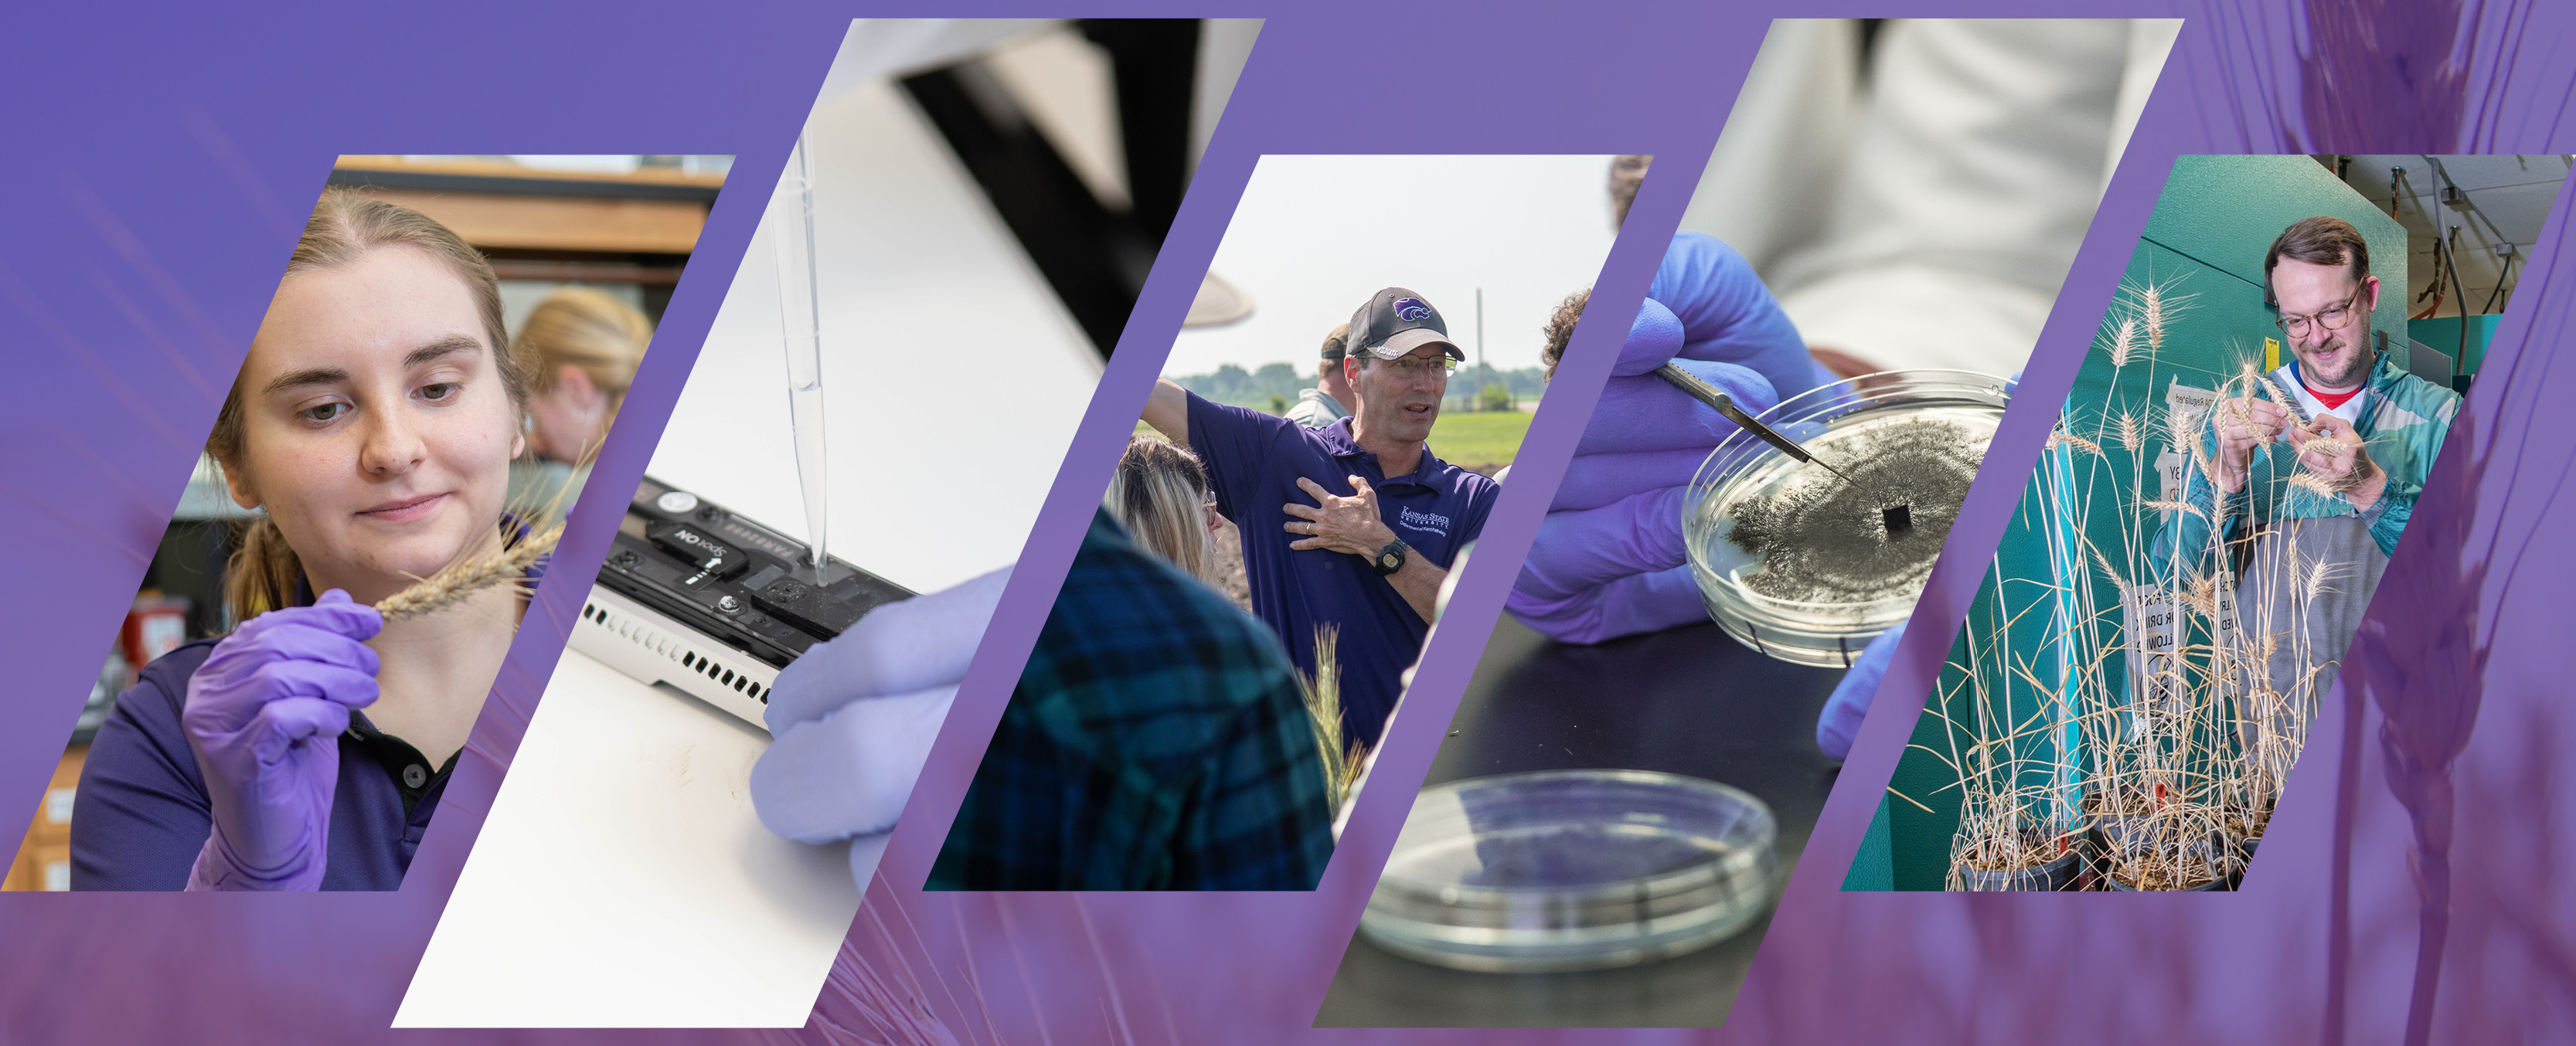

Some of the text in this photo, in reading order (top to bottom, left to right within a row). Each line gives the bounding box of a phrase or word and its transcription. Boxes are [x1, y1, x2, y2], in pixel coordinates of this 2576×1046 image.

[1400, 515, 1449, 529] UNIVERSITY
[1401, 505, 1450, 524] KANSAS STATE
[1400, 520, 1419, 531] Department
[674, 529, 727, 557] SpotON
